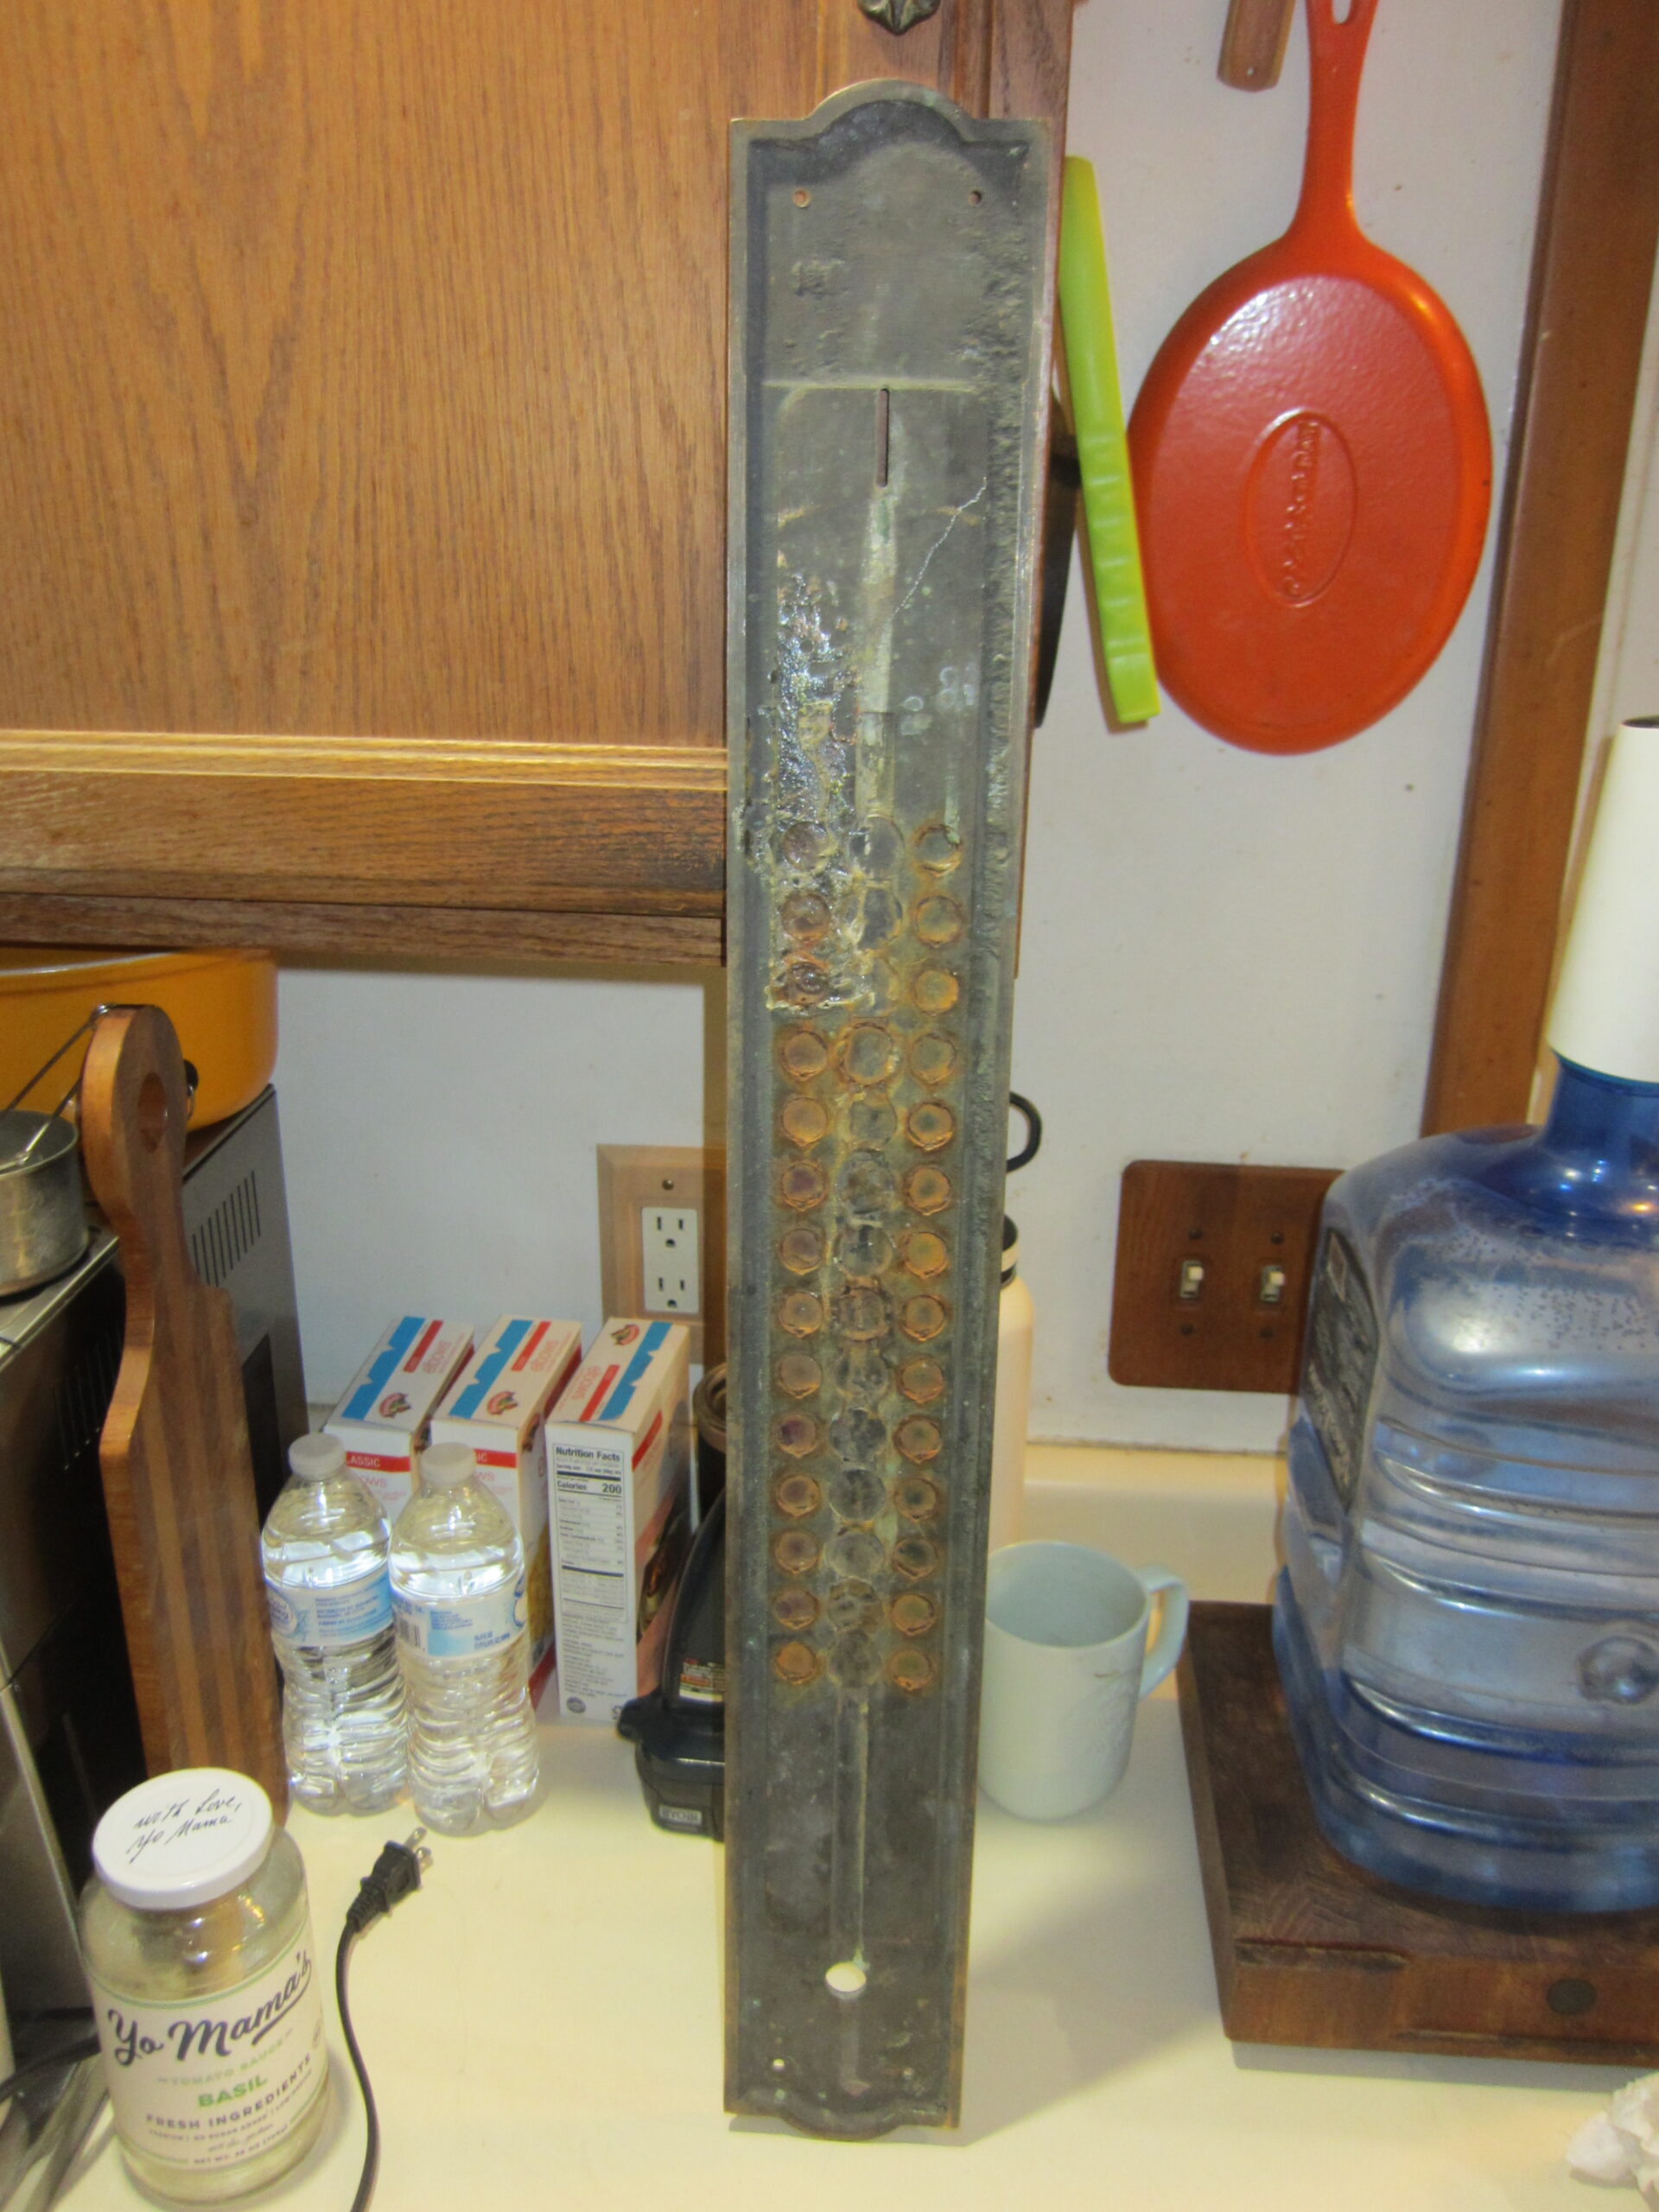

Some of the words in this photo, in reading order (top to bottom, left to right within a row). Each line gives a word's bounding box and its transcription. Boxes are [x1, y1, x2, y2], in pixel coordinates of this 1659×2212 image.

[556, 1446, 594, 1459] Nutrition
[596, 1451, 620, 1462] Facts
[556, 1480, 588, 1491] Calories
[602, 1483, 622, 1495] 200
[164, 1815, 234, 1846] Mama
[107, 2008, 164, 2068] Yo
[168, 1949, 312, 2063] Mama's
[146, 2113, 200, 2130] FRESH
[208, 2052, 310, 2128] INGREDIENTS
[198, 2075, 269, 2107] BASIL
